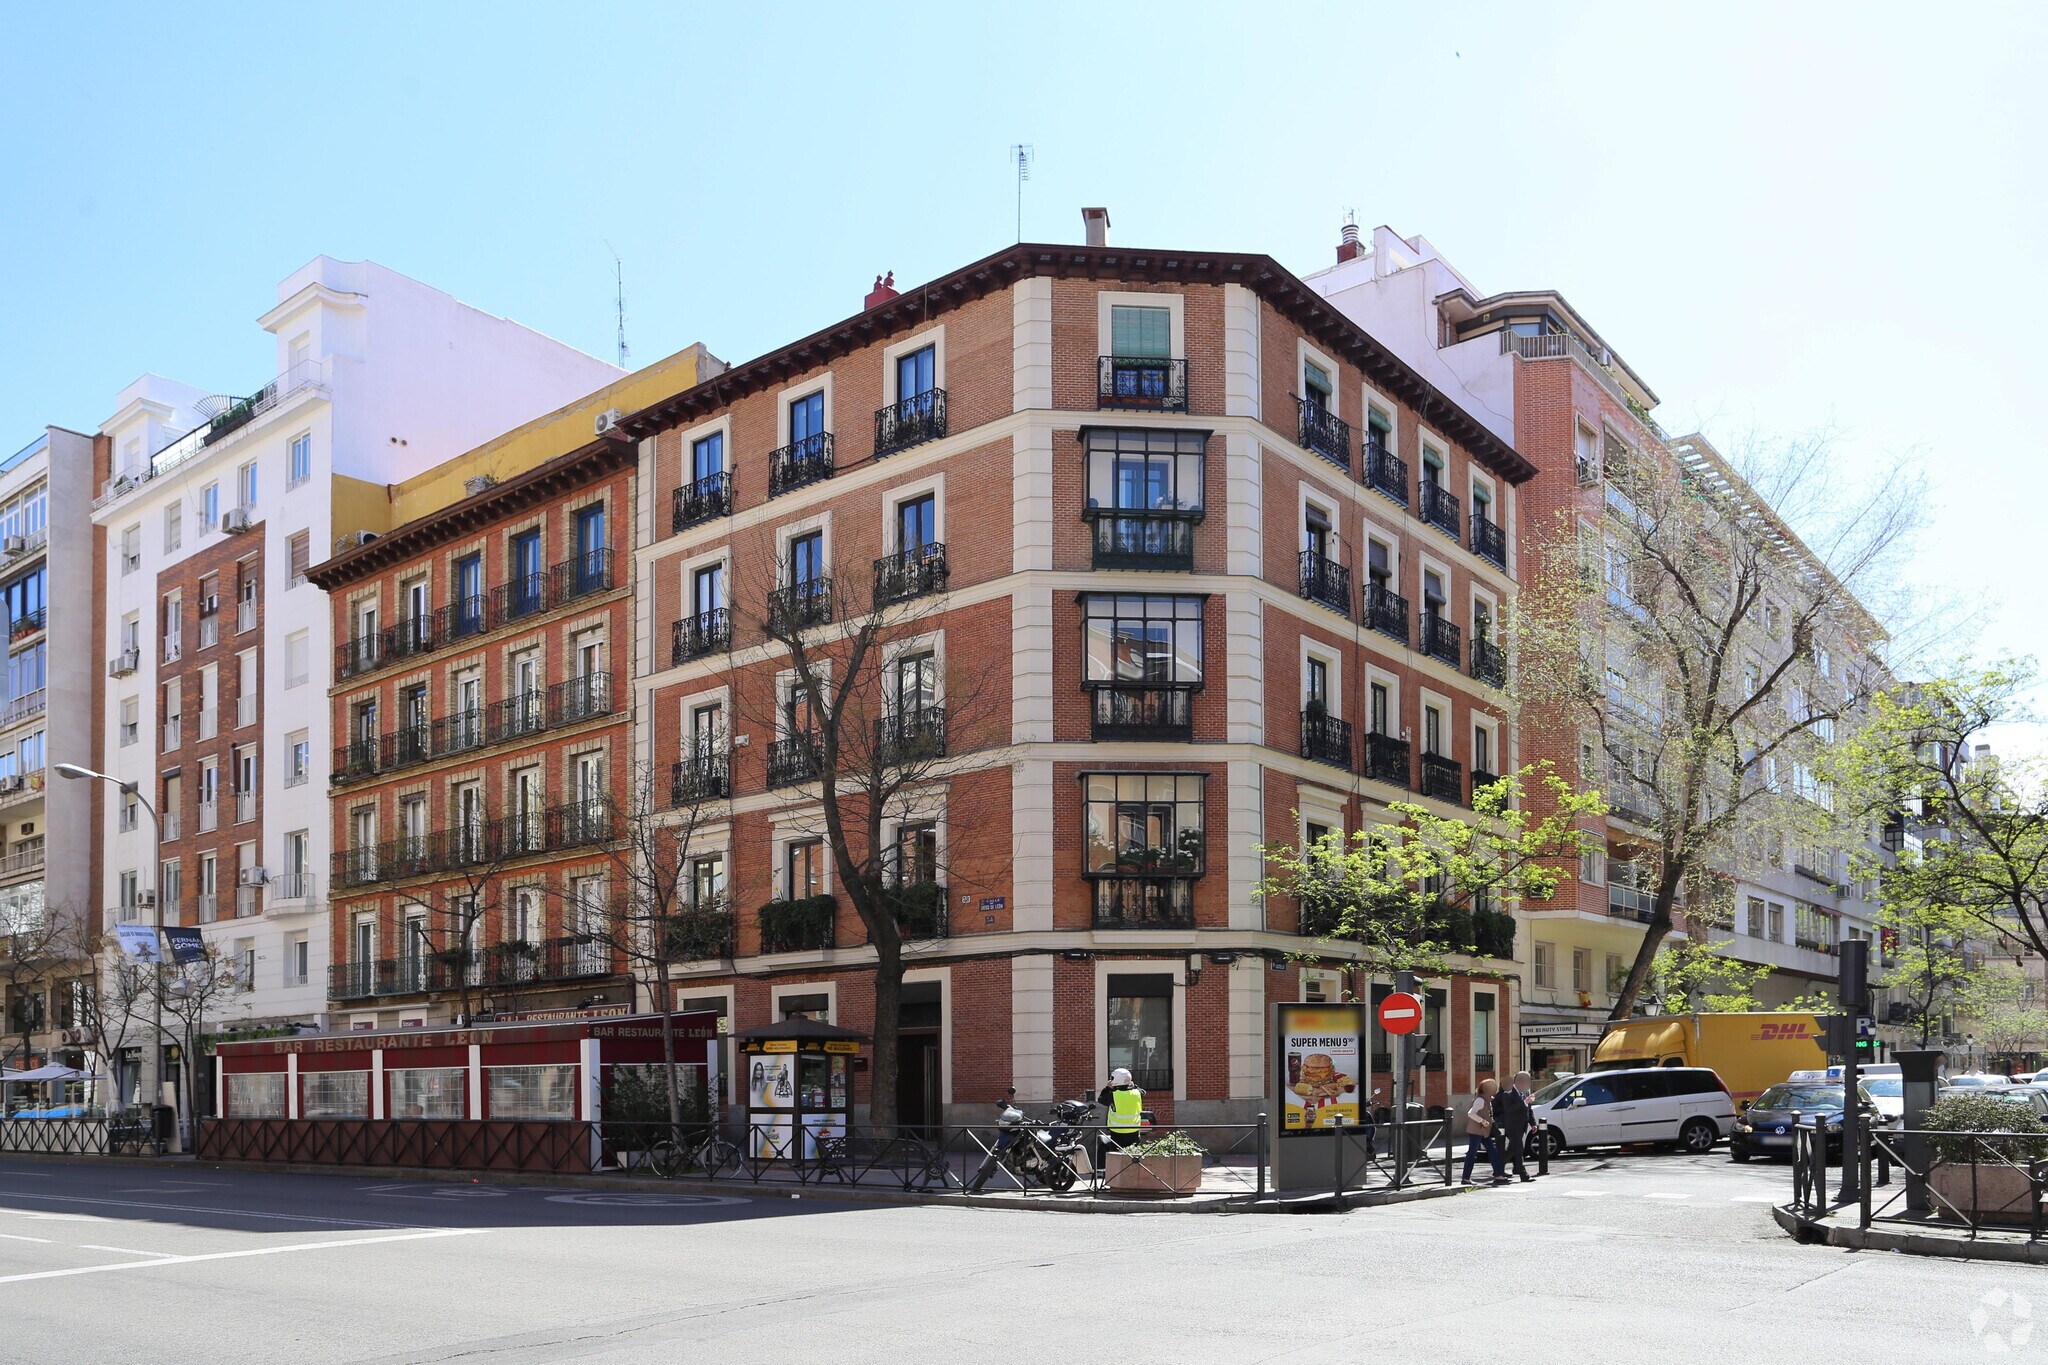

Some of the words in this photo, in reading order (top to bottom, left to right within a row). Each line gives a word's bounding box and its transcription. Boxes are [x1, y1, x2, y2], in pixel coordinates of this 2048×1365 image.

[594, 1027, 614, 1037] BAR
[689, 1026, 713, 1038] LEÓN
[1760, 1023, 1810, 1040] DHL
[274, 1041, 303, 1054] BAR
[315, 1034, 432, 1052] RESTAURANTE
[1291, 1037, 1317, 1047] SUPER
[1319, 1037, 1342, 1047] MENU
